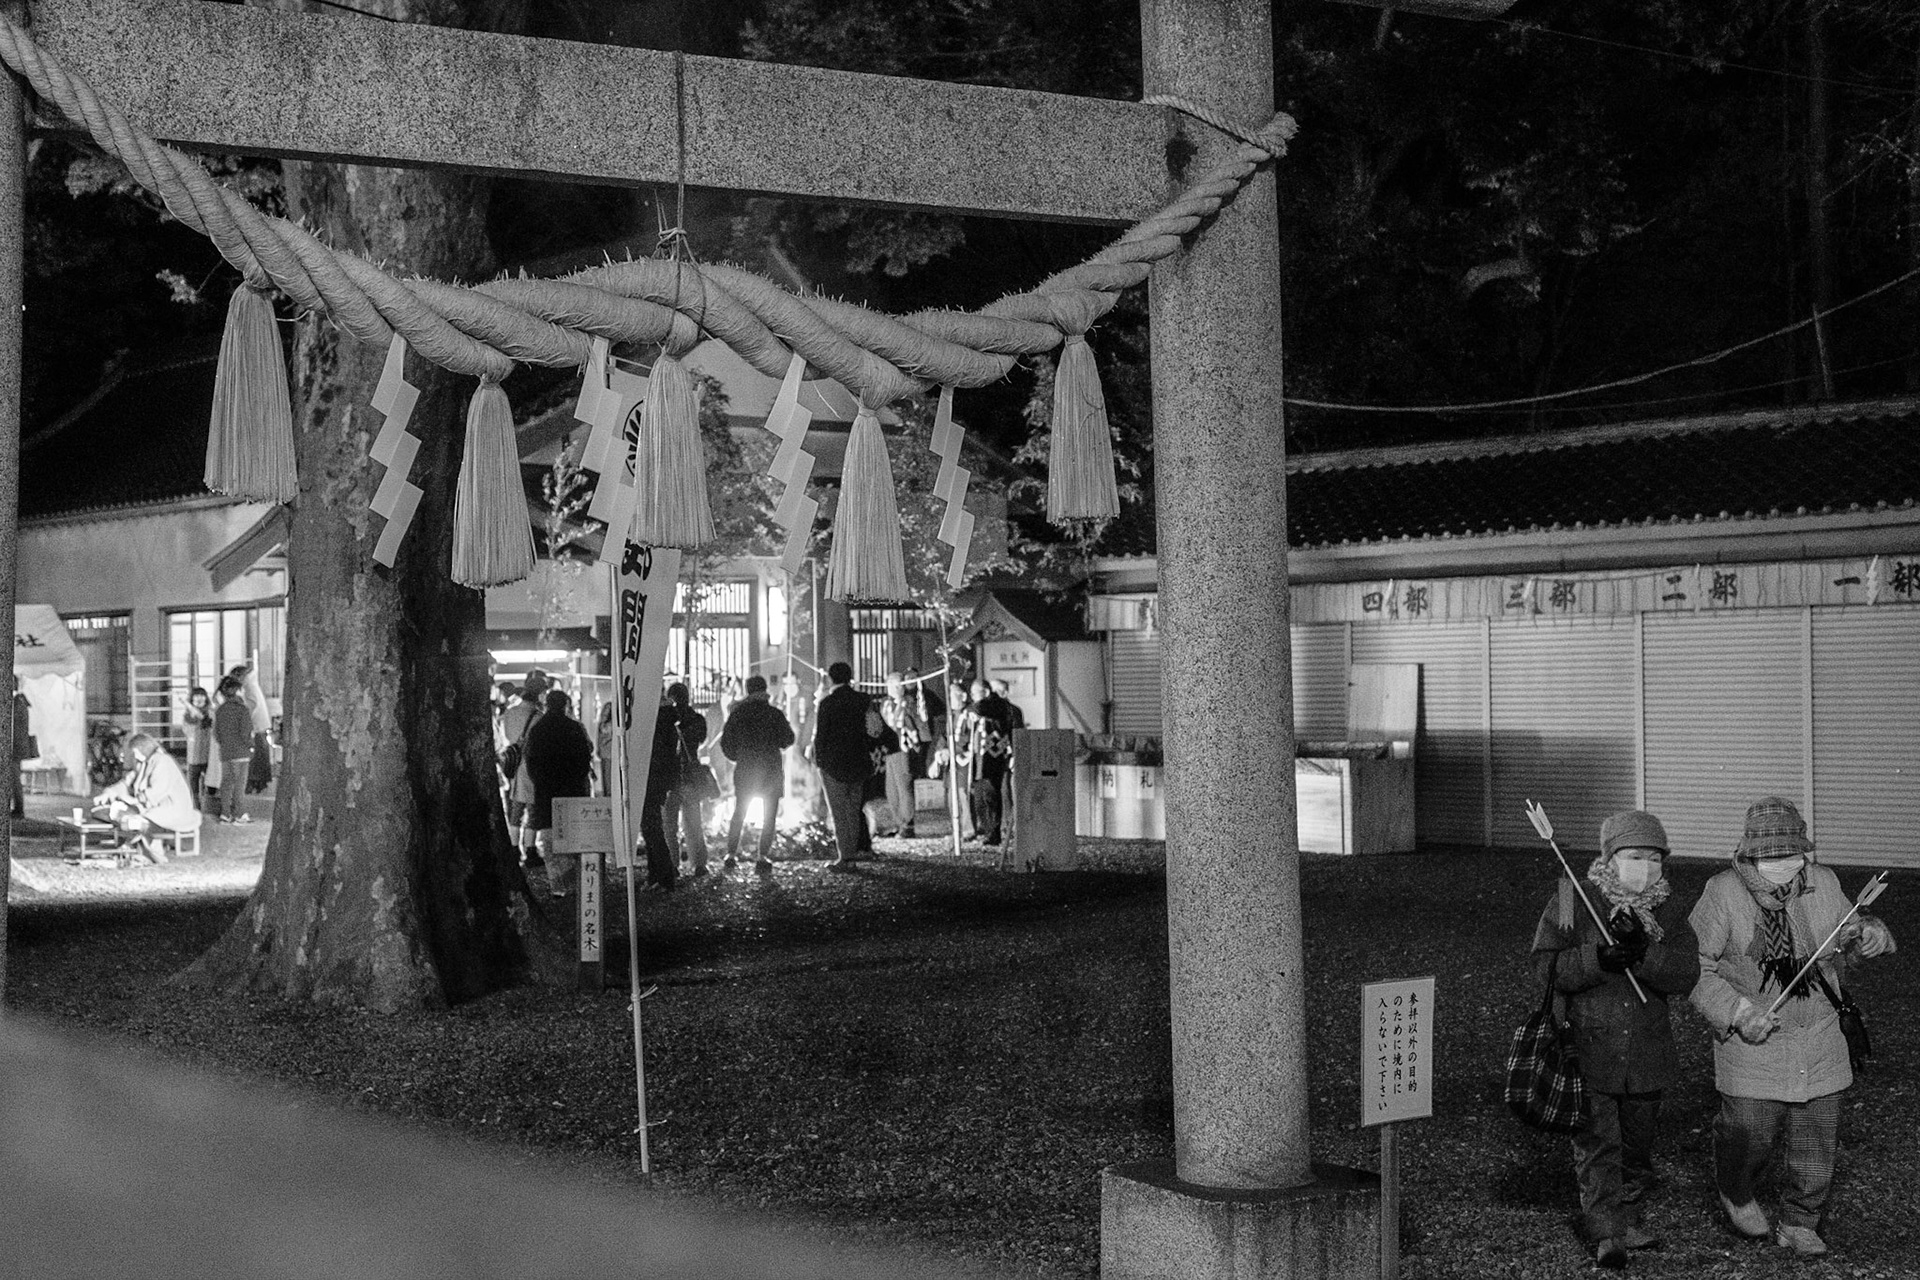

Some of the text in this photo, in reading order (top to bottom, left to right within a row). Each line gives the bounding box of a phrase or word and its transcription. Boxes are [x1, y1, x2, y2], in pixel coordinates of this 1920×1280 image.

[1362, 585, 1428, 615] 四部
[1662, 570, 1738, 604] 二部
[583, 860, 599, 951] ねりまの名木
[1378, 997, 1388, 1111] 入らないで下さい
[1392, 995, 1403, 1095] のために境内に
[1408, 992, 1419, 1093] 参拝以外の目的
